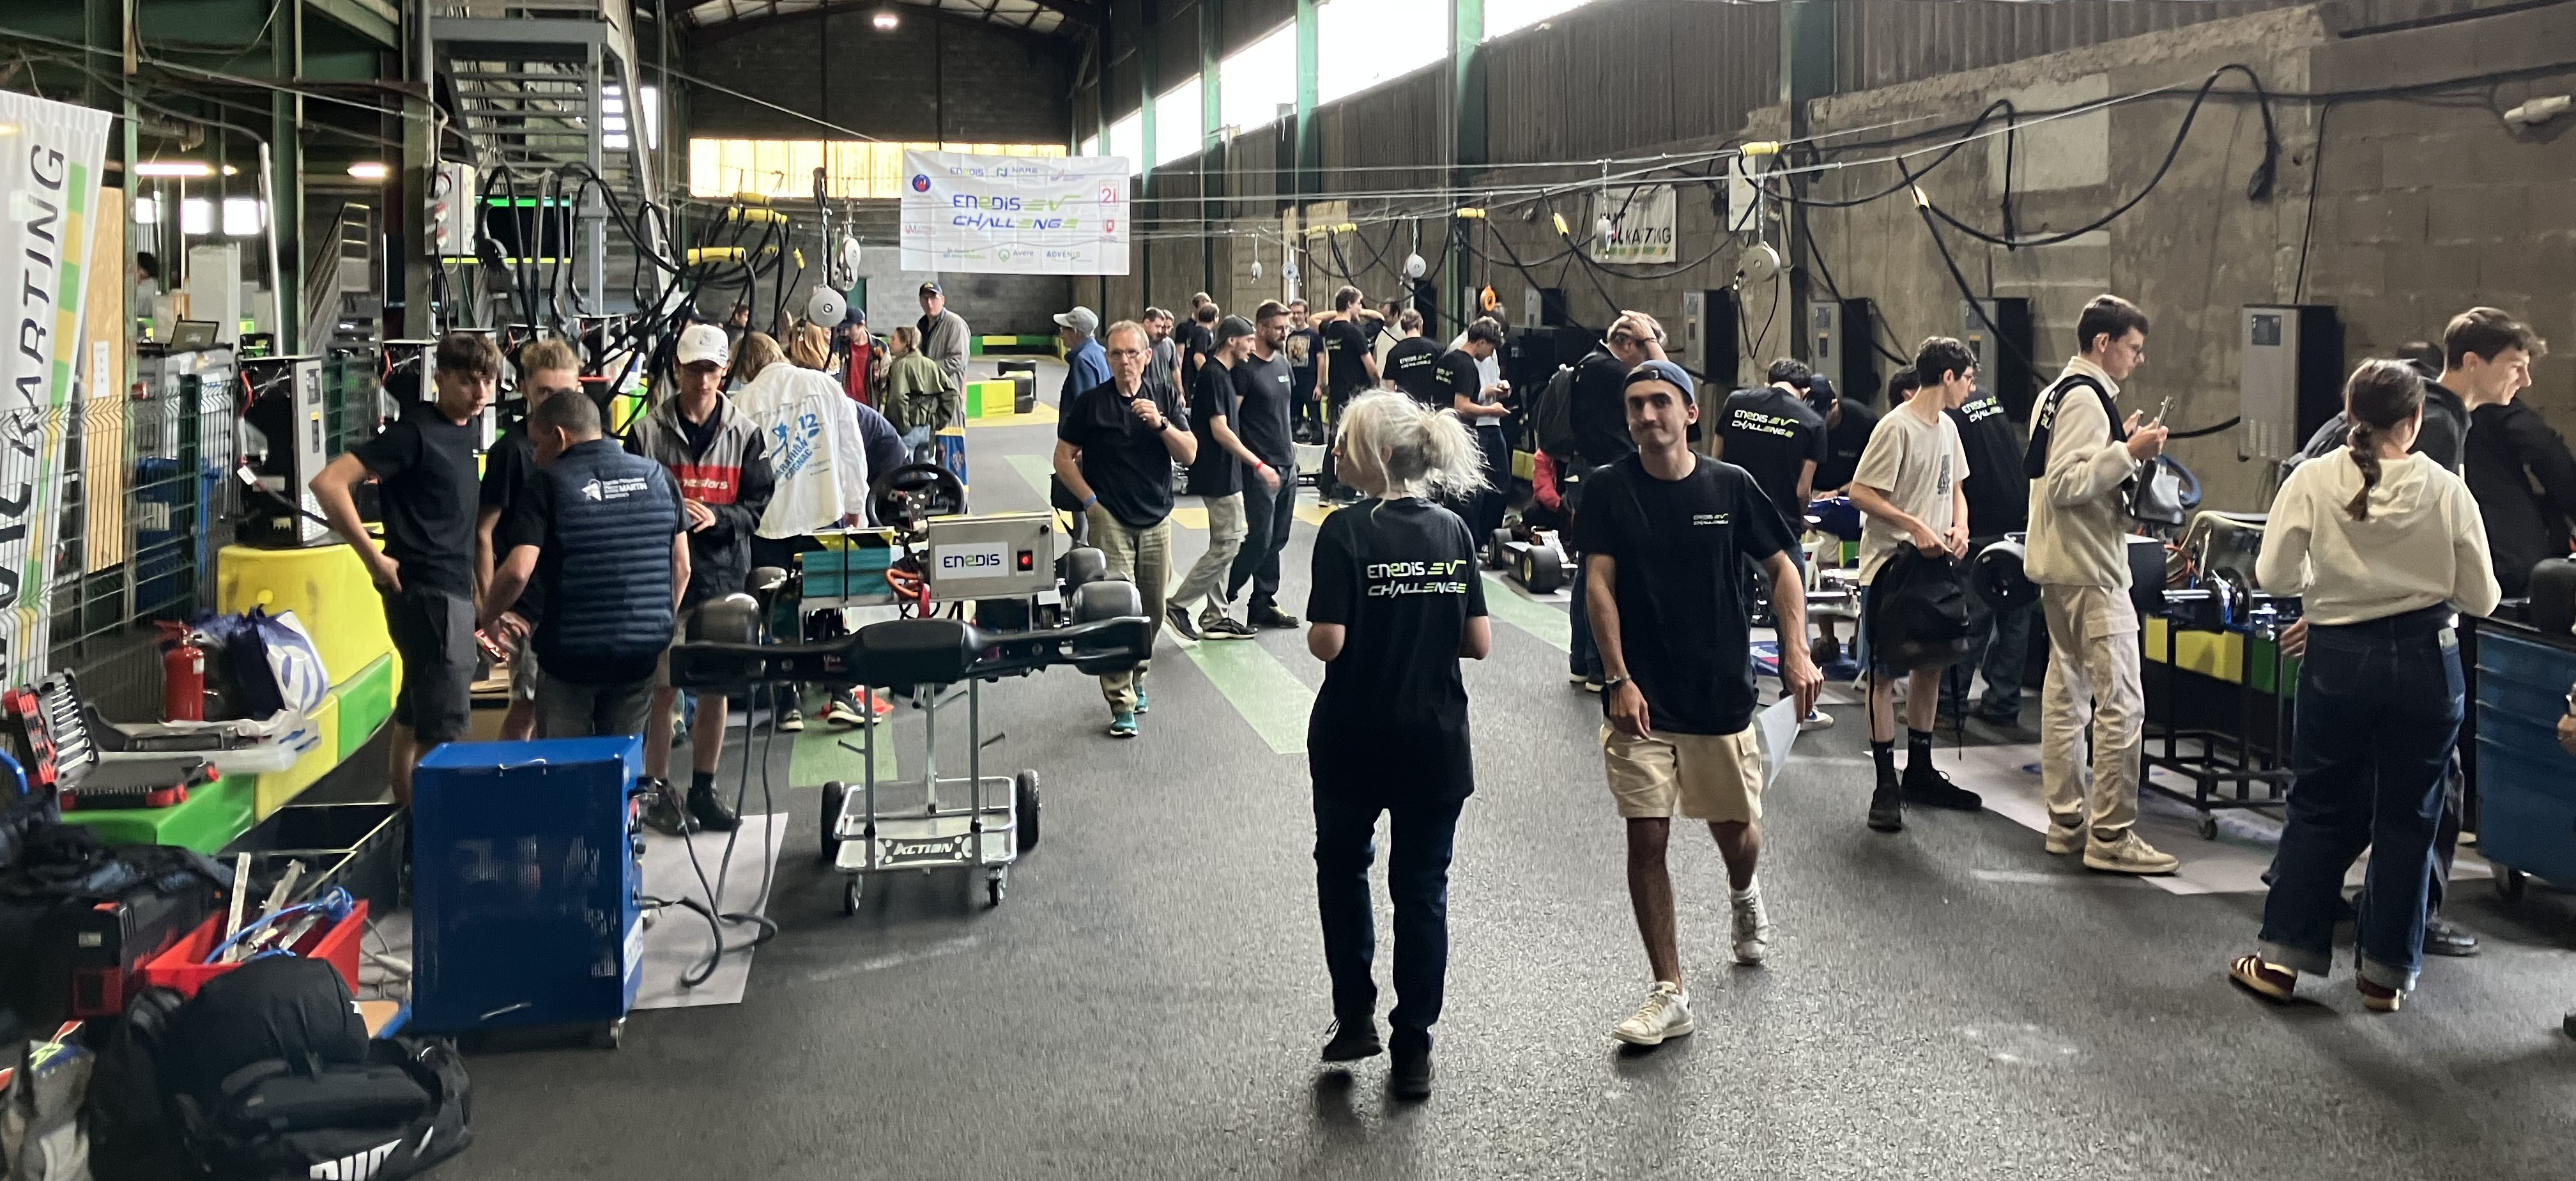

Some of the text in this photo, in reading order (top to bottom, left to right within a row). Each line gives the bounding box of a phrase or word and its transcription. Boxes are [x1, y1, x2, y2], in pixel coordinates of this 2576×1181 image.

[952, 213, 1079, 231] CHALLENGE
[10, 143, 65, 458] KARTING
[799, 413, 818, 430] 12
[774, 438, 809, 481] ARATHON
[1367, 580, 1467, 599] CHALLENGE
